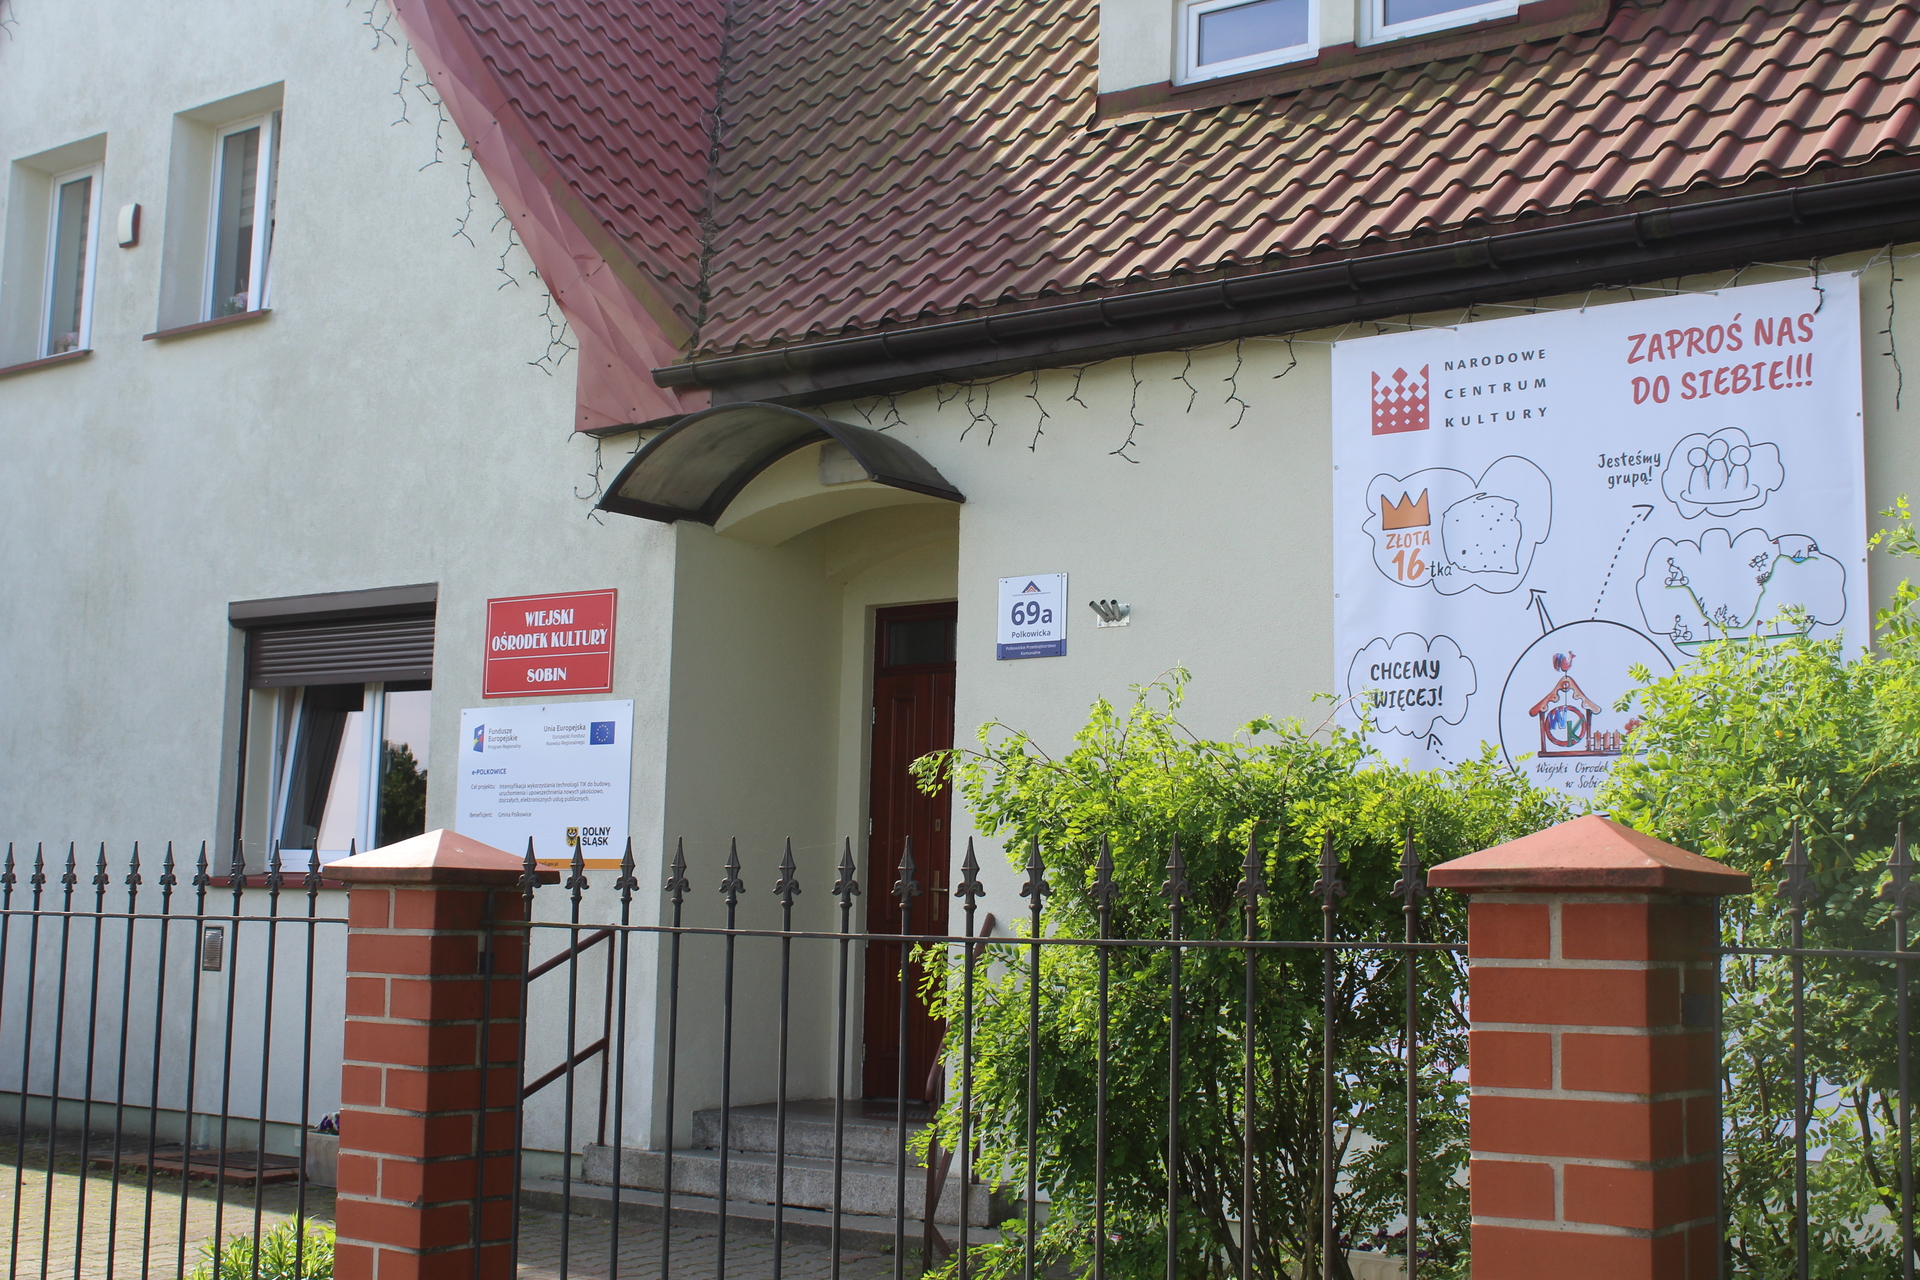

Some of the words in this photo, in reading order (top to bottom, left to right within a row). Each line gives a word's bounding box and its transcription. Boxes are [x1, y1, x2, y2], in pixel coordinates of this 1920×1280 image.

[1627, 312, 1743, 364] ZAPROŚ
[1754, 313, 1815, 347] NAS
[1444, 349, 1546, 371] NARODOWE
[1444, 378, 1546, 399] CENTRUM
[1631, 375, 1670, 405] DO
[1680, 353, 1813, 400] SIEBIE!!!
[1444, 407, 1547, 428] KULTURY
[1597, 450, 1661, 468] Jesteśmy
[1608, 465, 1652, 489] grupą!
[1385, 530, 1431, 549] ZŁOTA
[525, 608, 574, 627] WIEJSKI
[1011, 600, 1052, 626] 69a
[491, 631, 548, 651] OŚRODEK
[551, 628, 608, 648] KULTURY
[1011, 629, 1051, 639] Polkowicka
[526, 667, 567, 683] SOBIN
[1370, 659, 1440, 681] CHCEMY
[1373, 685, 1443, 711] WIĘCEJ!
[556, 724, 587, 732] Europejska
[488, 735, 519, 743] Europejskie
[1535, 761, 1569, 782] Wiejski
[520, 796, 552, 804] elektronicznych
[581, 836, 609, 847] ŚLĄSK
[582, 827, 611, 836] DOLNY
